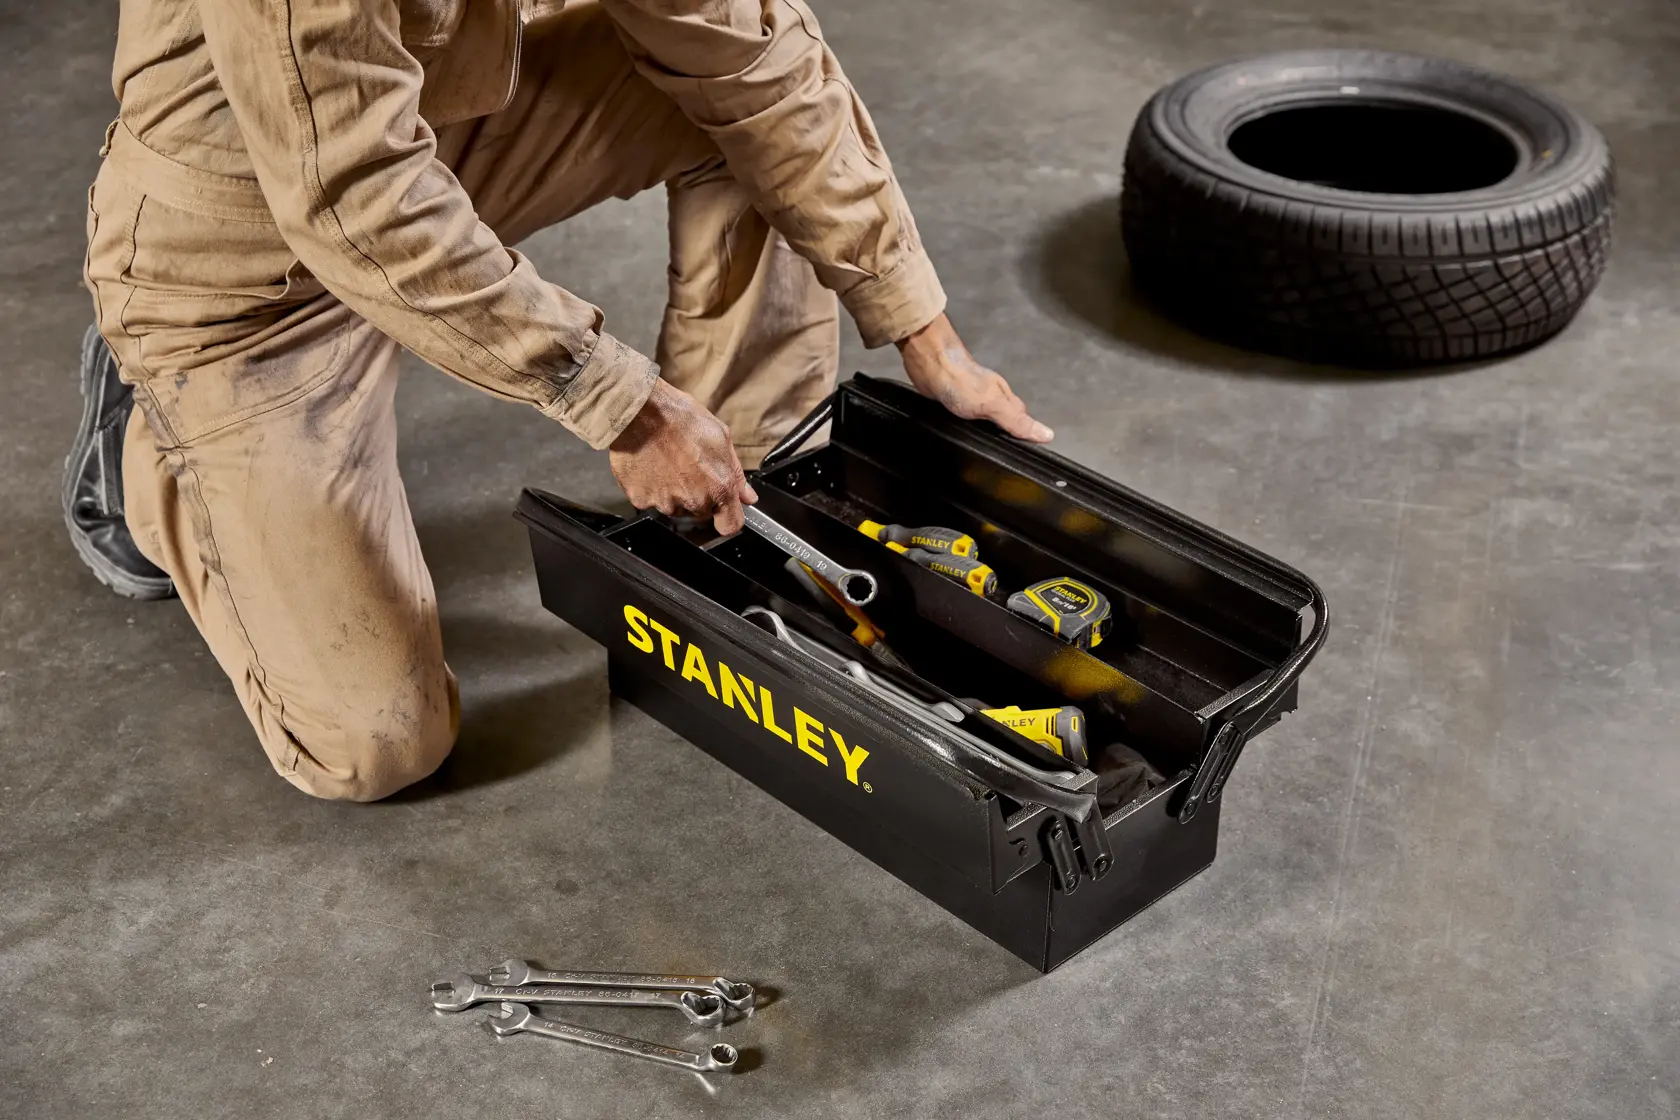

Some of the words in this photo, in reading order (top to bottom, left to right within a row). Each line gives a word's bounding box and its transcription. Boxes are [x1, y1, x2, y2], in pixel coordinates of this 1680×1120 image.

[911, 536, 950, 549] STANLEY
[930, 562, 967, 578] STANLEY
[1054, 586, 1087, 603] STANLEY
[623, 604, 870, 786] STANLEY
[1002, 717, 1036, 728] NLEY
